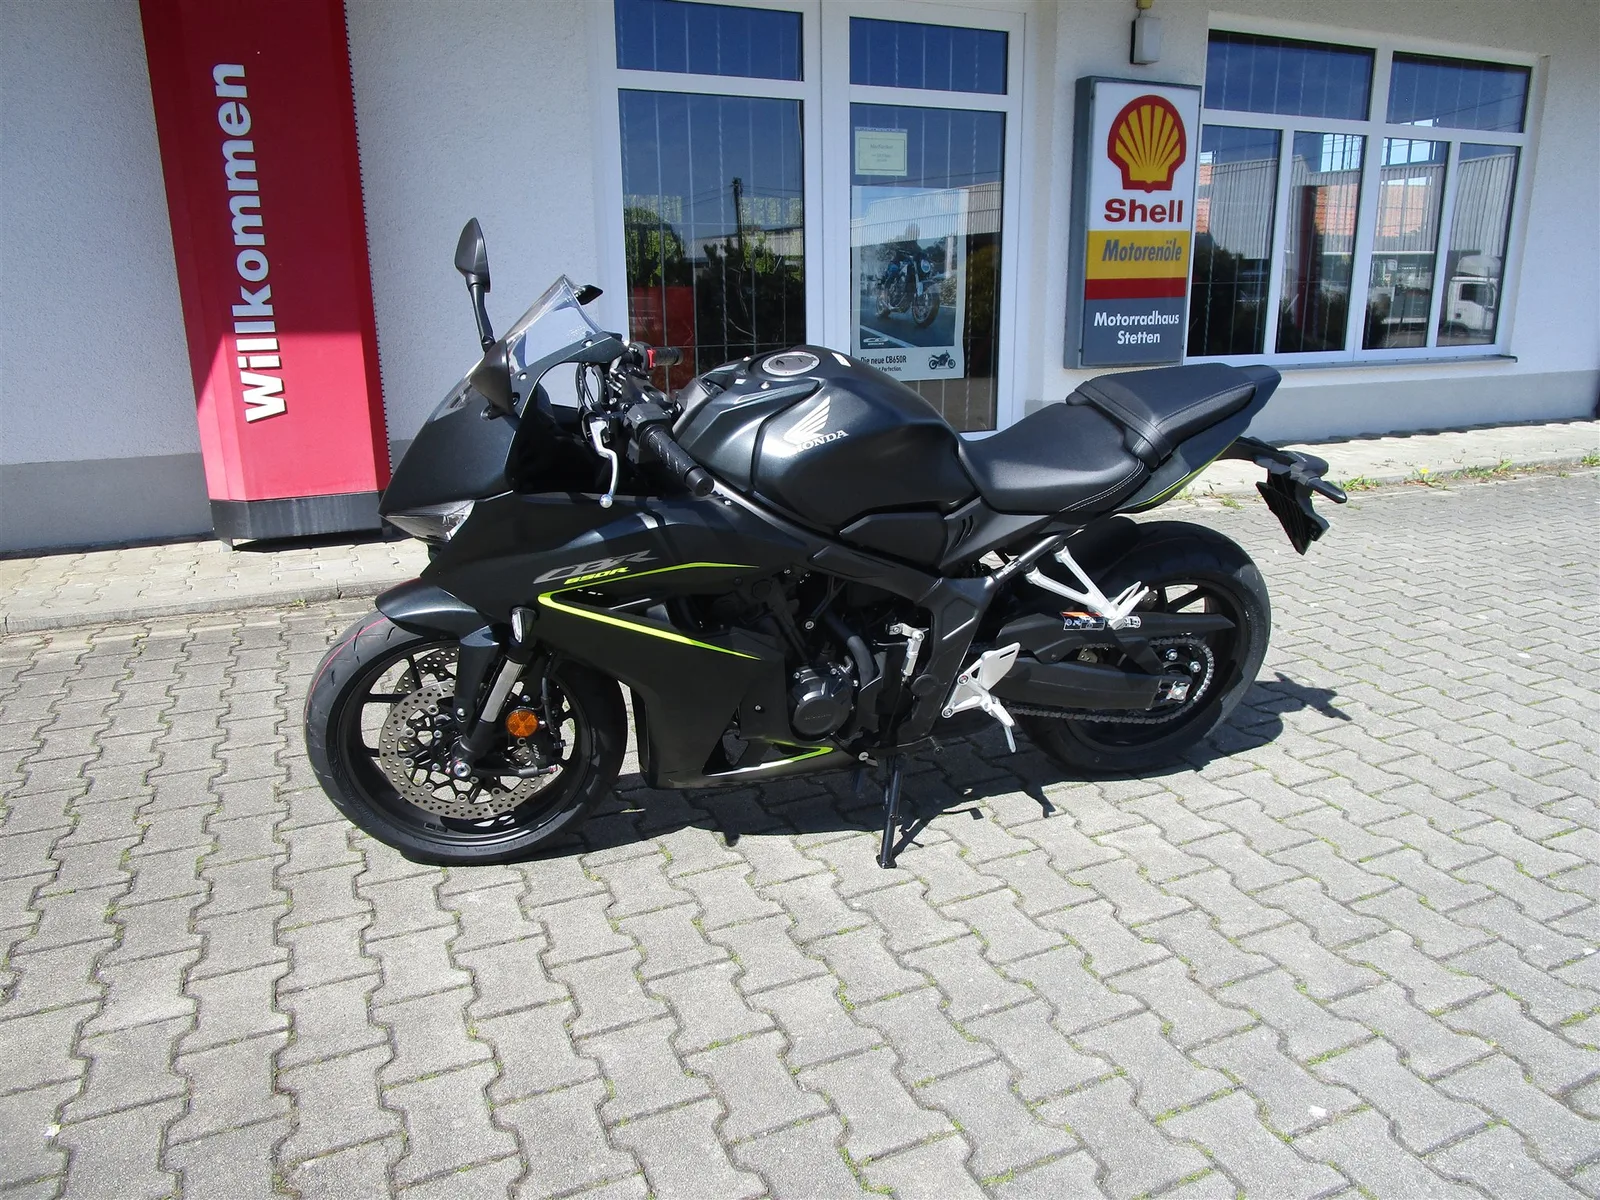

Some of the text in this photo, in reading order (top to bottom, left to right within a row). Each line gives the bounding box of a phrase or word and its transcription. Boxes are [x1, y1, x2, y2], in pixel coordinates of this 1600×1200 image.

[1104, 198, 1183, 223] Shell
[212, 62, 287, 423] Willkommen
[1102, 237, 1182, 262] Motorenöle
[1094, 311, 1180, 326] Motorradhaus
[1117, 330, 1161, 345] Stetten
[870, 357, 885, 365] neue
[885, 355, 907, 364] CB650R
[533, 550, 660, 584] CBR
[564, 566, 631, 585] 650R
